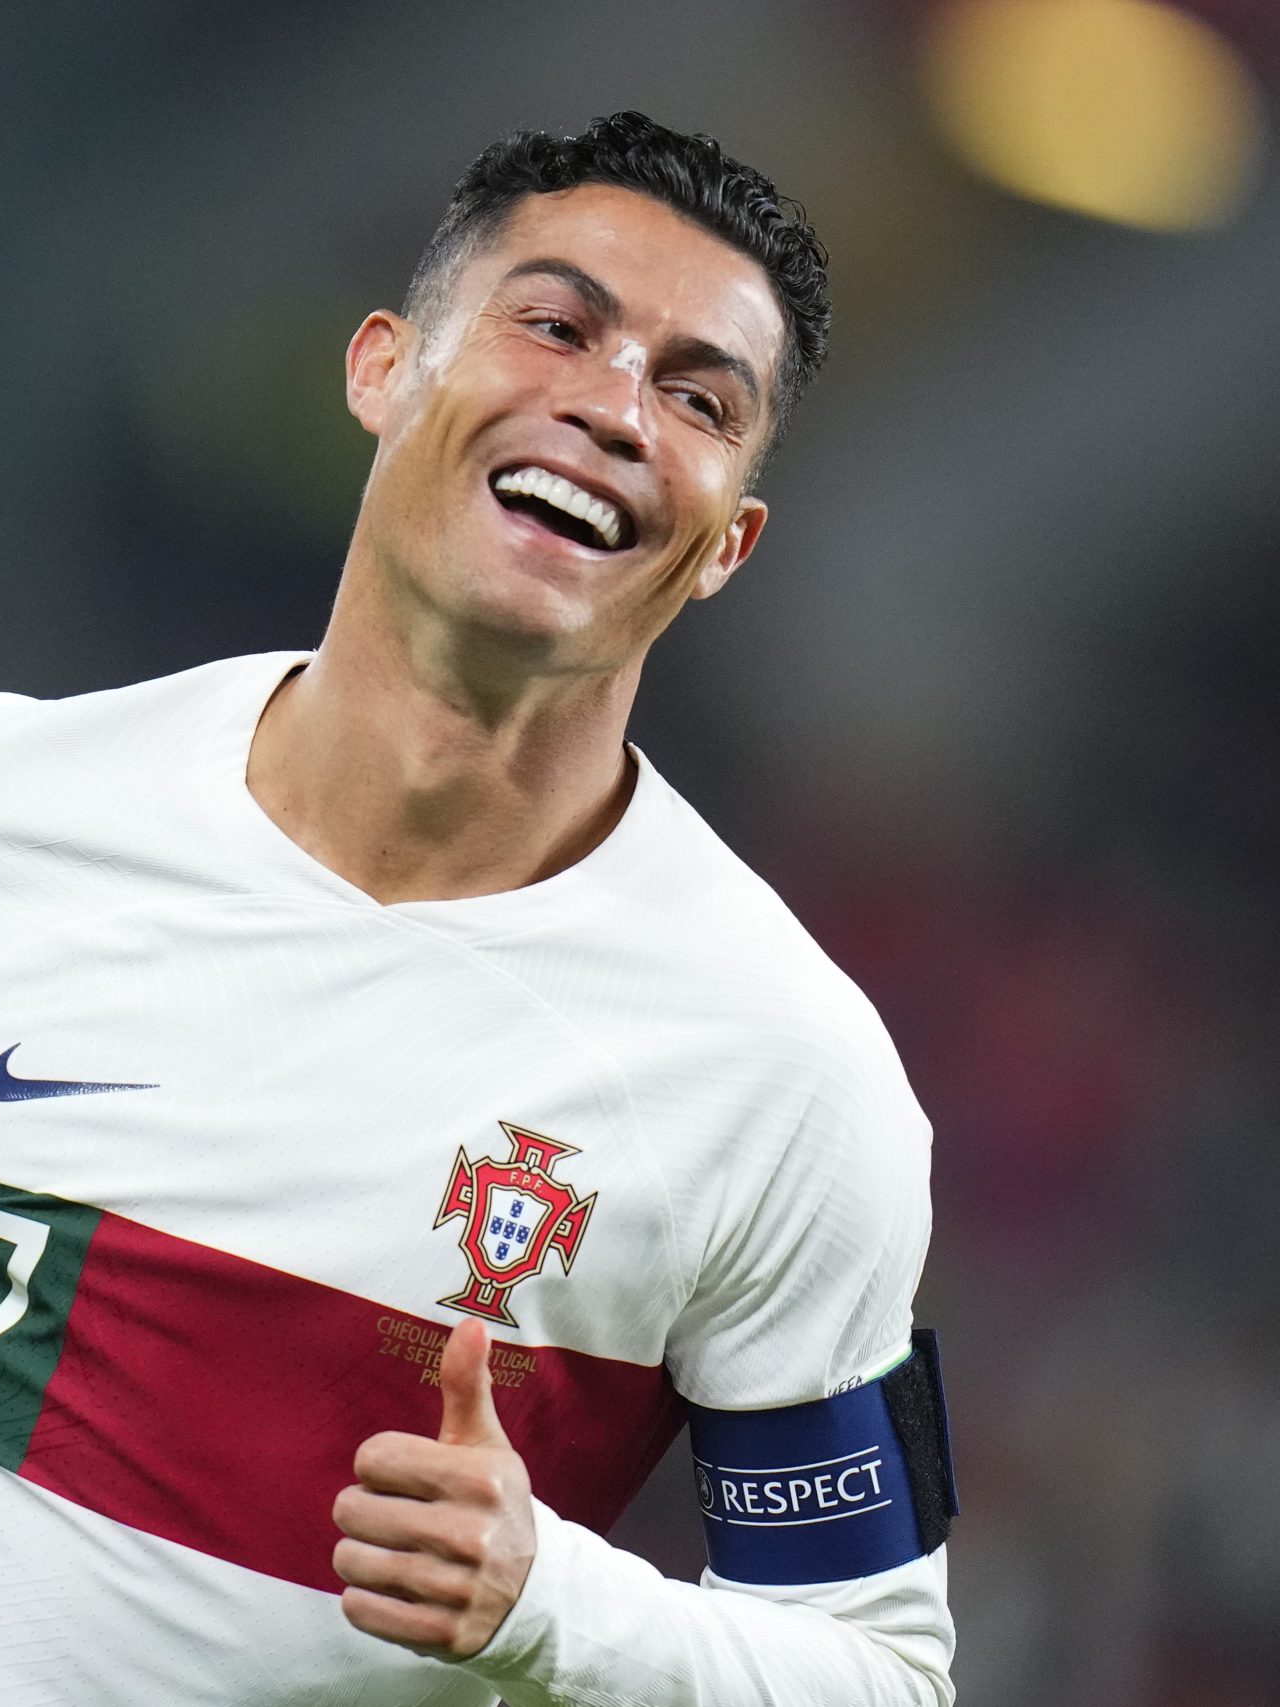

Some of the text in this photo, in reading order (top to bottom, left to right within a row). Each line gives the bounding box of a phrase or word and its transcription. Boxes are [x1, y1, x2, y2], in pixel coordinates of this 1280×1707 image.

[378, 1337, 401, 1357] 24
[491, 1368, 526, 1388] 2022
[721, 1459, 882, 1515] RESPECT
